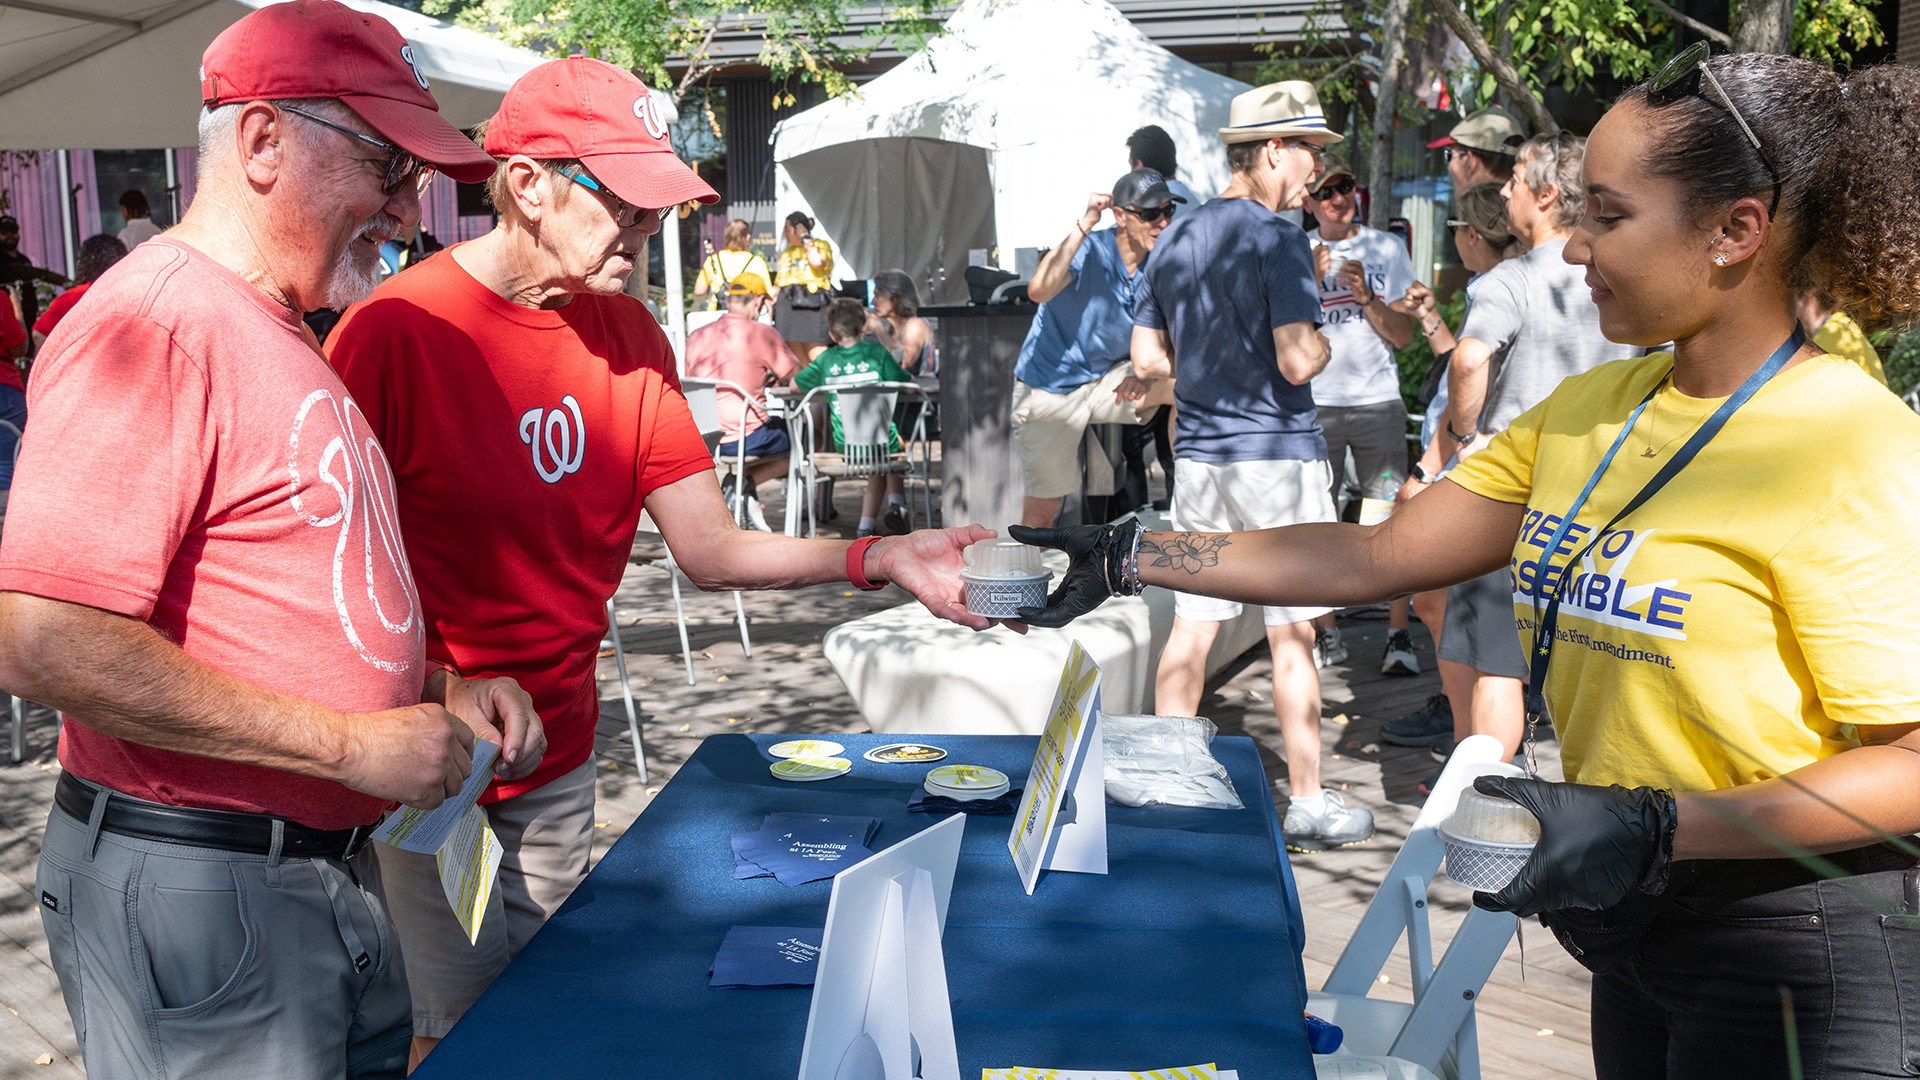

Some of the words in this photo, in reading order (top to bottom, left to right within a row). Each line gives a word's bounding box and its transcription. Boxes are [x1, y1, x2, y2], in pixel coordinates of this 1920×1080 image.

[632, 94, 668, 140] W
[518, 394, 586, 484] W
[1519, 507, 1592, 556] REE
[993, 594, 1019, 602] Kilwins
[1510, 556, 1692, 630] SSEMBLE
[1568, 628, 1591, 647] First
[1588, 640, 1676, 670] mendment.
[793, 841, 847, 850] Assembling
